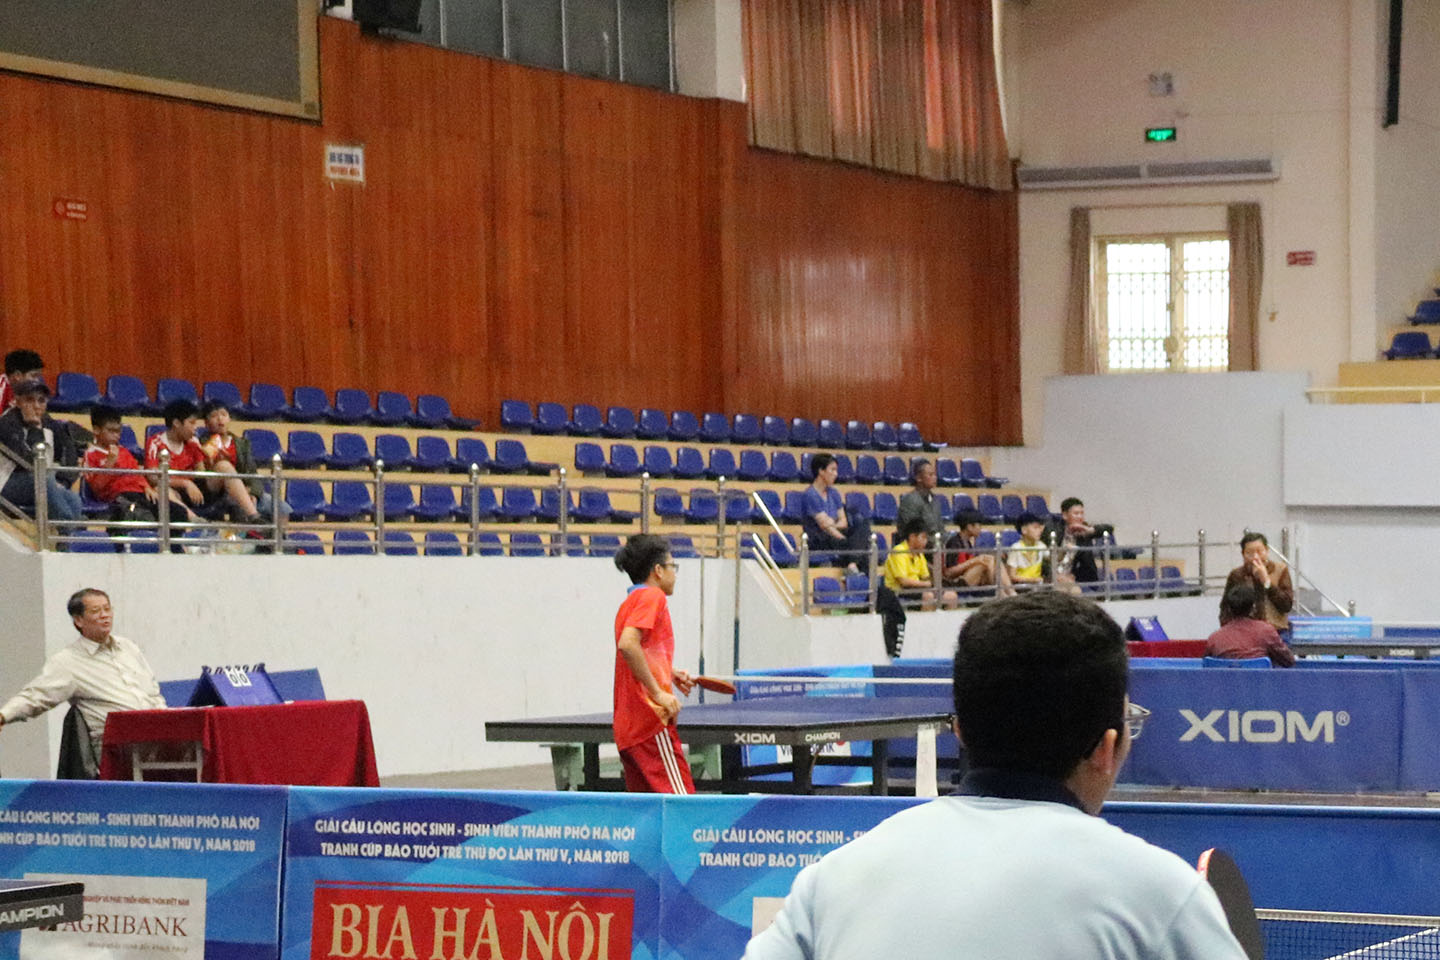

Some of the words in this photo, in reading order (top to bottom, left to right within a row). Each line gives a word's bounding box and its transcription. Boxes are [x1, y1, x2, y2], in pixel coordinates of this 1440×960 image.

[734, 733, 776, 744] XIOM
[805, 732, 840, 742] CHAMPION
[429, 822, 456, 836] SINH
[464, 823, 490, 837] SINH
[815, 830, 843, 844] SINH
[321, 843, 359, 856] TRANH
[604, 850, 630, 864] 2018
[699, 853, 740, 867] TRANH
[63, 914, 188, 937] AGRIBANK
[328, 903, 417, 960] BIA
